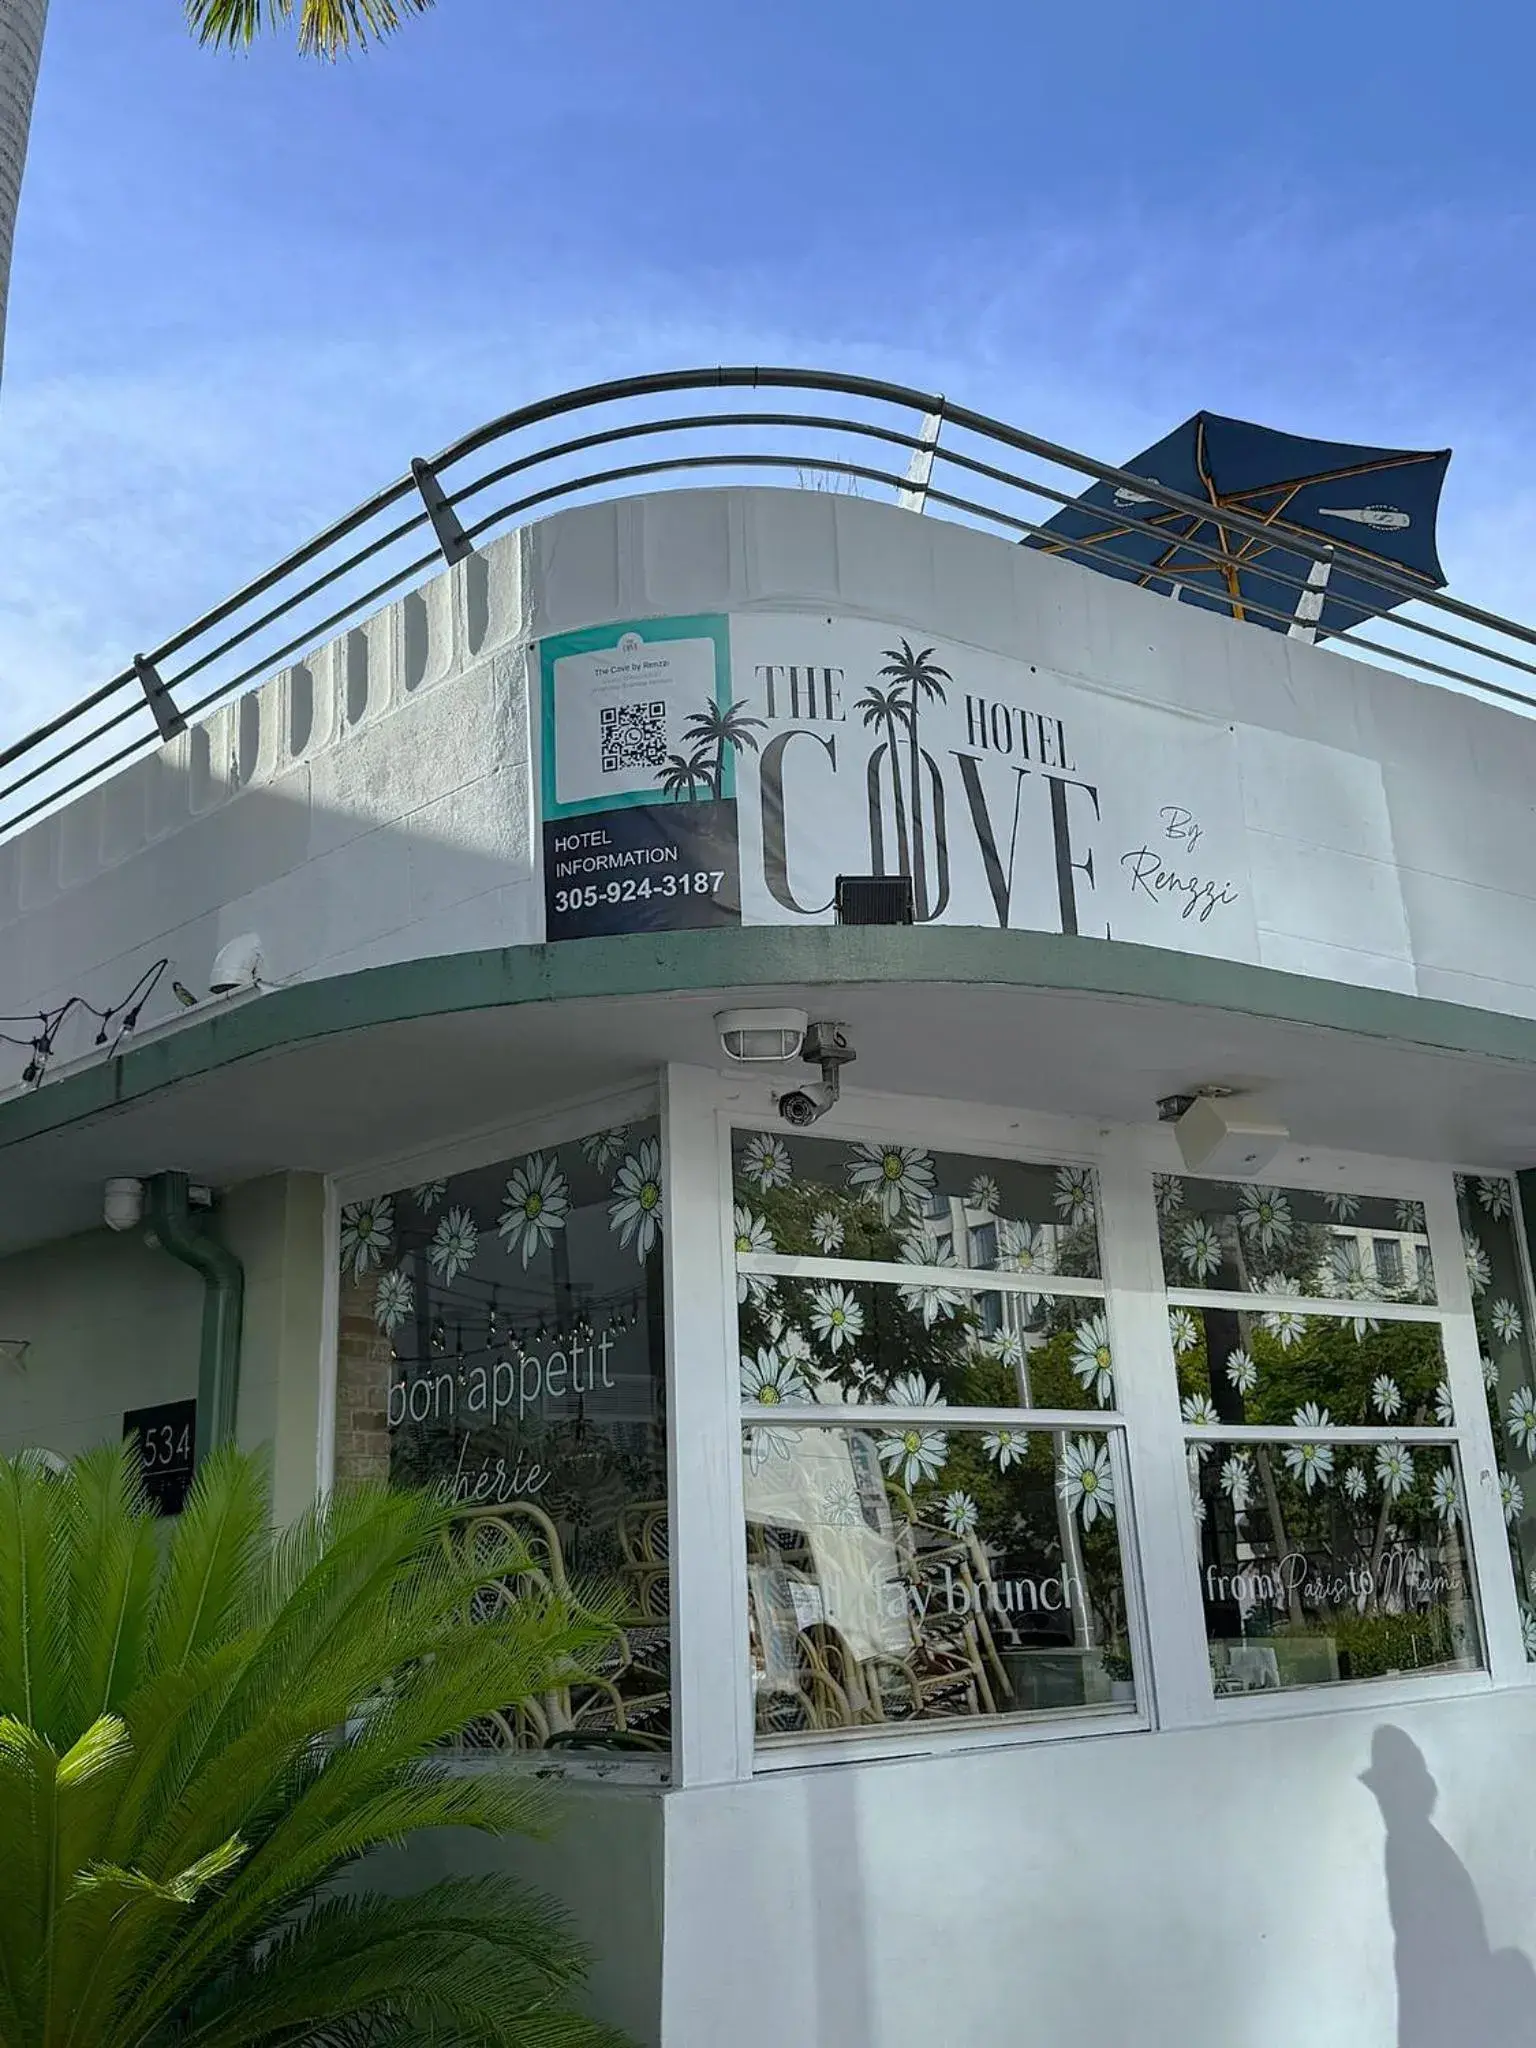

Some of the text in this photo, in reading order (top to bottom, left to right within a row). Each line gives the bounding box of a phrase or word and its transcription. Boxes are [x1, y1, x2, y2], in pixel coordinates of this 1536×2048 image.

[755, 664, 846, 722] THE
[964, 694, 1077, 772] HOTEL
[554, 830, 612, 853] HOTEL
[1160, 806, 1203, 853] By
[556, 845, 679, 879] INFORMATION
[1120, 845, 1238, 922] Renzzi
[554, 870, 725, 912] 305-924-3187
[387, 1331, 615, 1427] bon appetit
[143, 1424, 190, 1467] 534
[944, 1562, 1080, 1616] brunch
[1206, 1564, 1275, 1601] from
[1278, 1553, 1347, 1607] Paris
[1349, 1566, 1374, 1596] to
